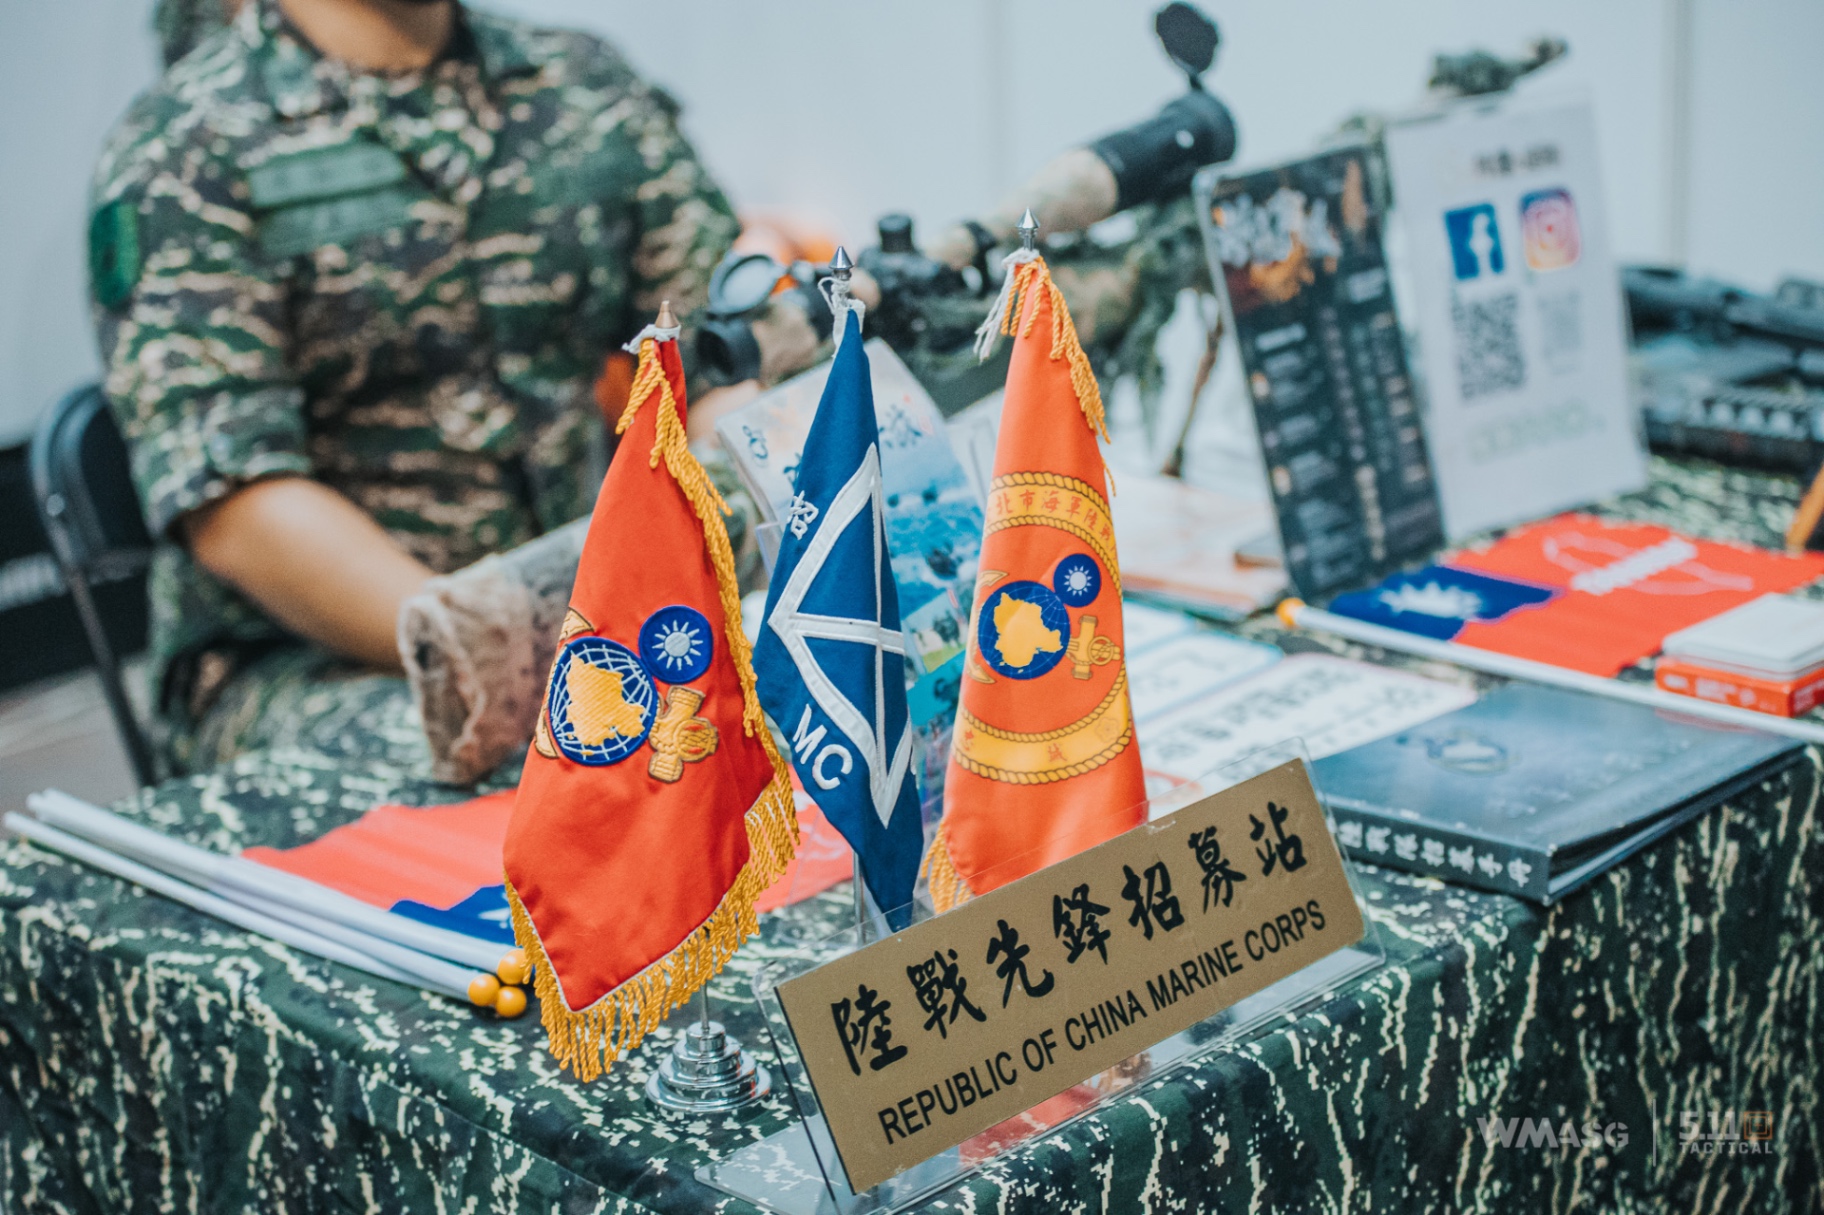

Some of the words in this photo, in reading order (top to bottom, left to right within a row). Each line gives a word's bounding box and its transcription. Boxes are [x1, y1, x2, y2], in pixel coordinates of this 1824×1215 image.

[793, 704, 853, 790] MC
[831, 802, 1307, 1076] 陸戰先鋒招募站
[878, 1052, 1017, 1145] REPUBLIC
[1022, 1028, 1057, 1072] OF
[1065, 990, 1147, 1051] CHINA
[1146, 940, 1243, 1011] MARINE
[1245, 899, 1325, 961] CORPS
